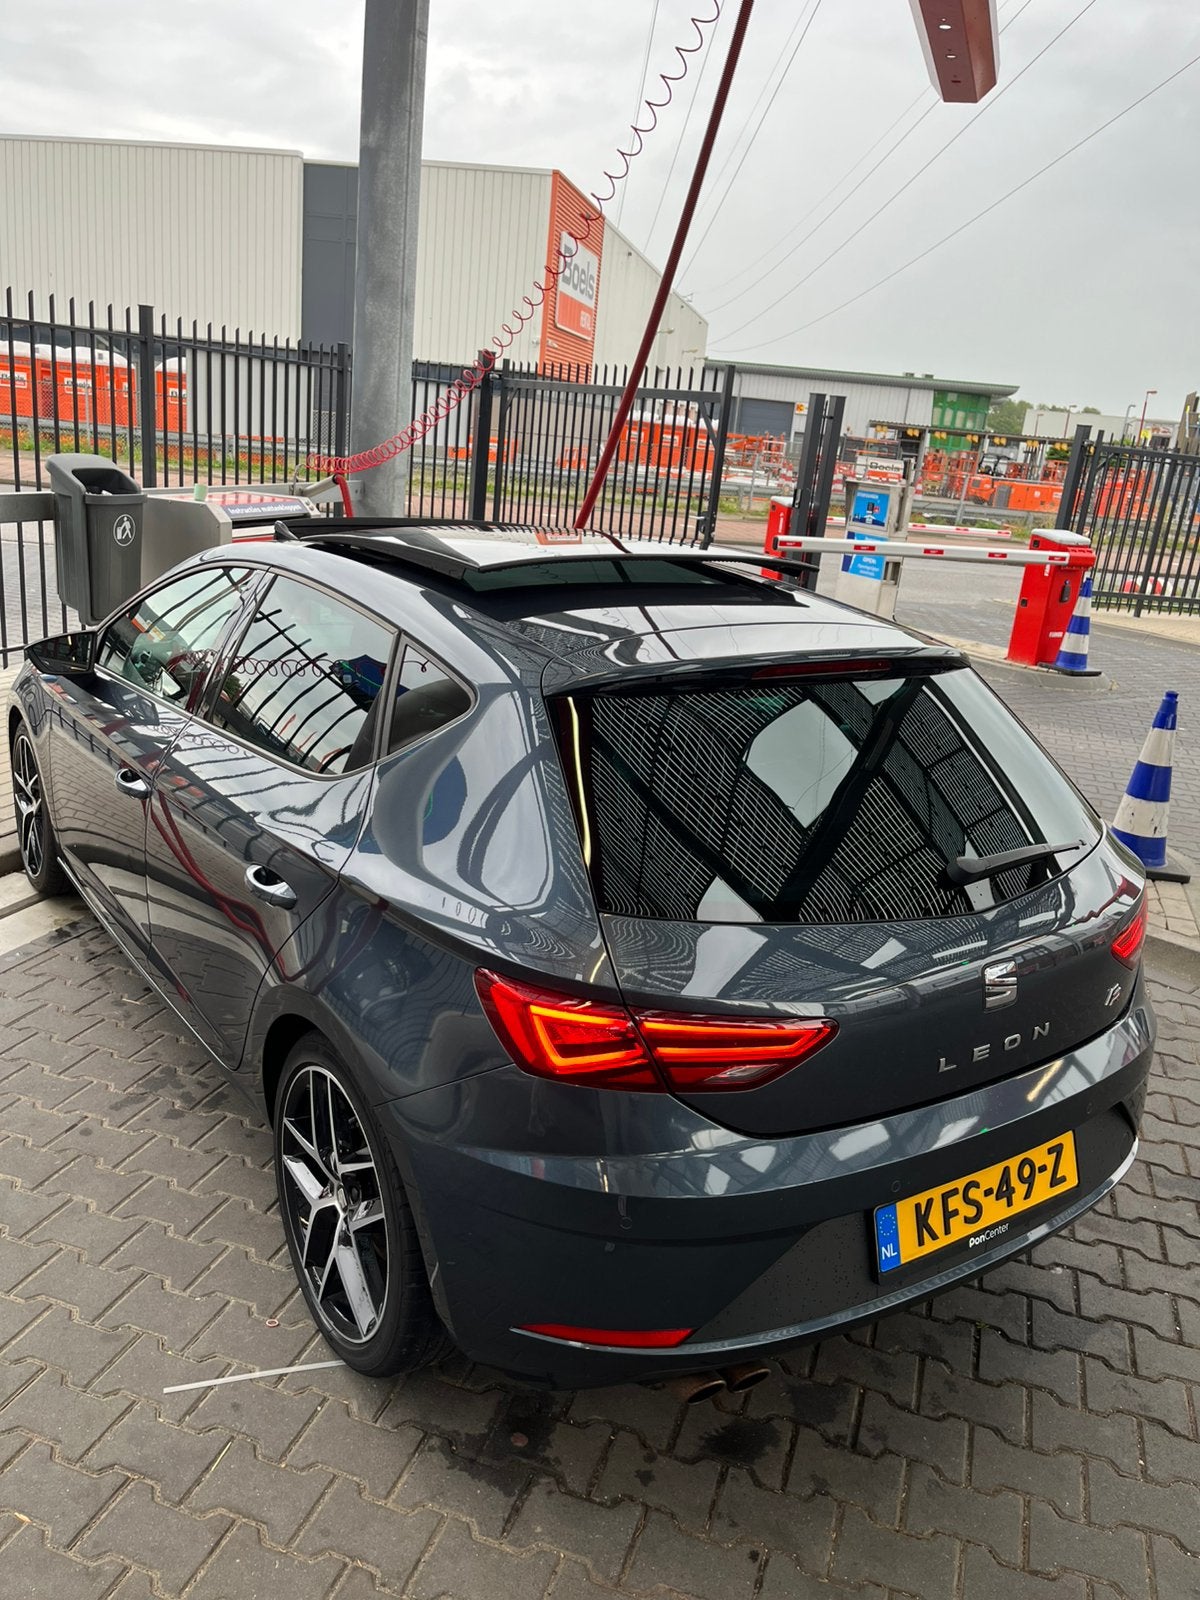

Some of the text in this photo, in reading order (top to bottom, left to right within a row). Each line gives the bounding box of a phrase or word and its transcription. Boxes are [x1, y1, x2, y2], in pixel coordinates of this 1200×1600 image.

[562, 244, 594, 300] Boels
[869, 461, 901, 472] Boels
[938, 1022, 1050, 1073] LEON
[914, 1142, 1067, 1248] KFS-49-Z
[881, 1243, 898, 1260] NL
